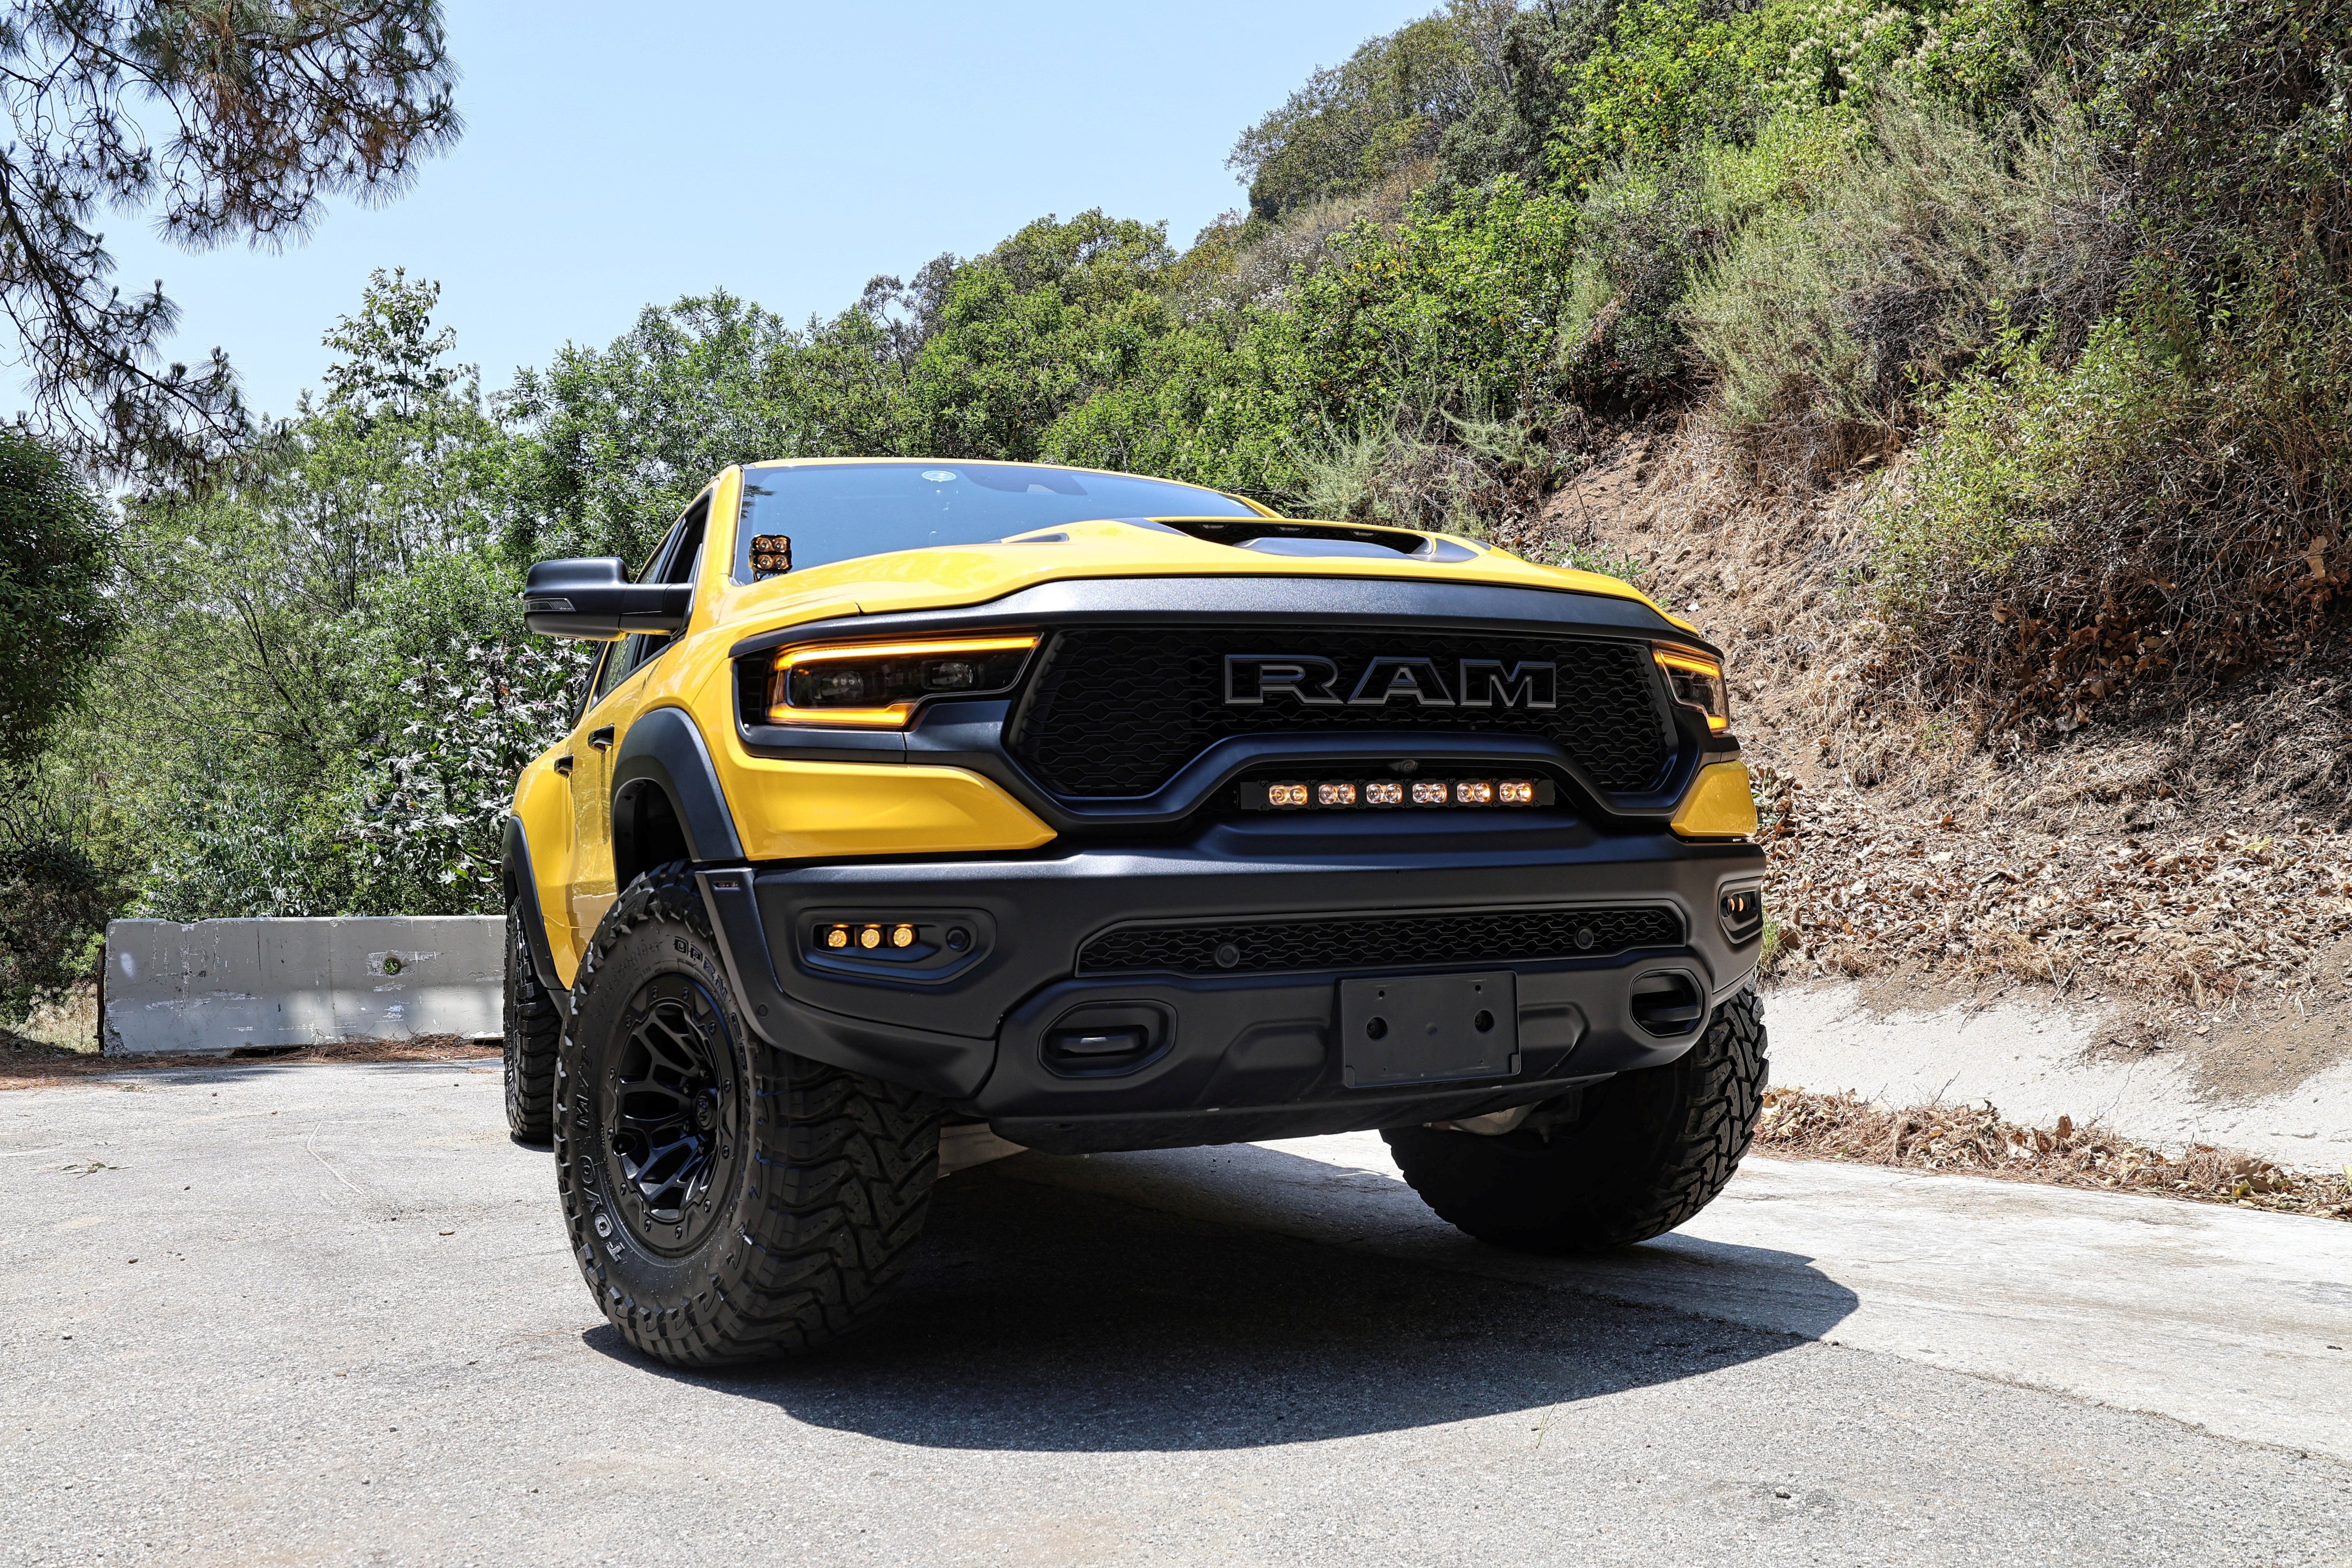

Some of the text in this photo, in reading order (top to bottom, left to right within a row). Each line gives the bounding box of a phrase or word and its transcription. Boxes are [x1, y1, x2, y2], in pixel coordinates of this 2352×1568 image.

[1223, 654, 1557, 709] RAM
[674, 936, 728, 1001] OPEN
[576, 1045, 625, 1264] TOYO M/T
